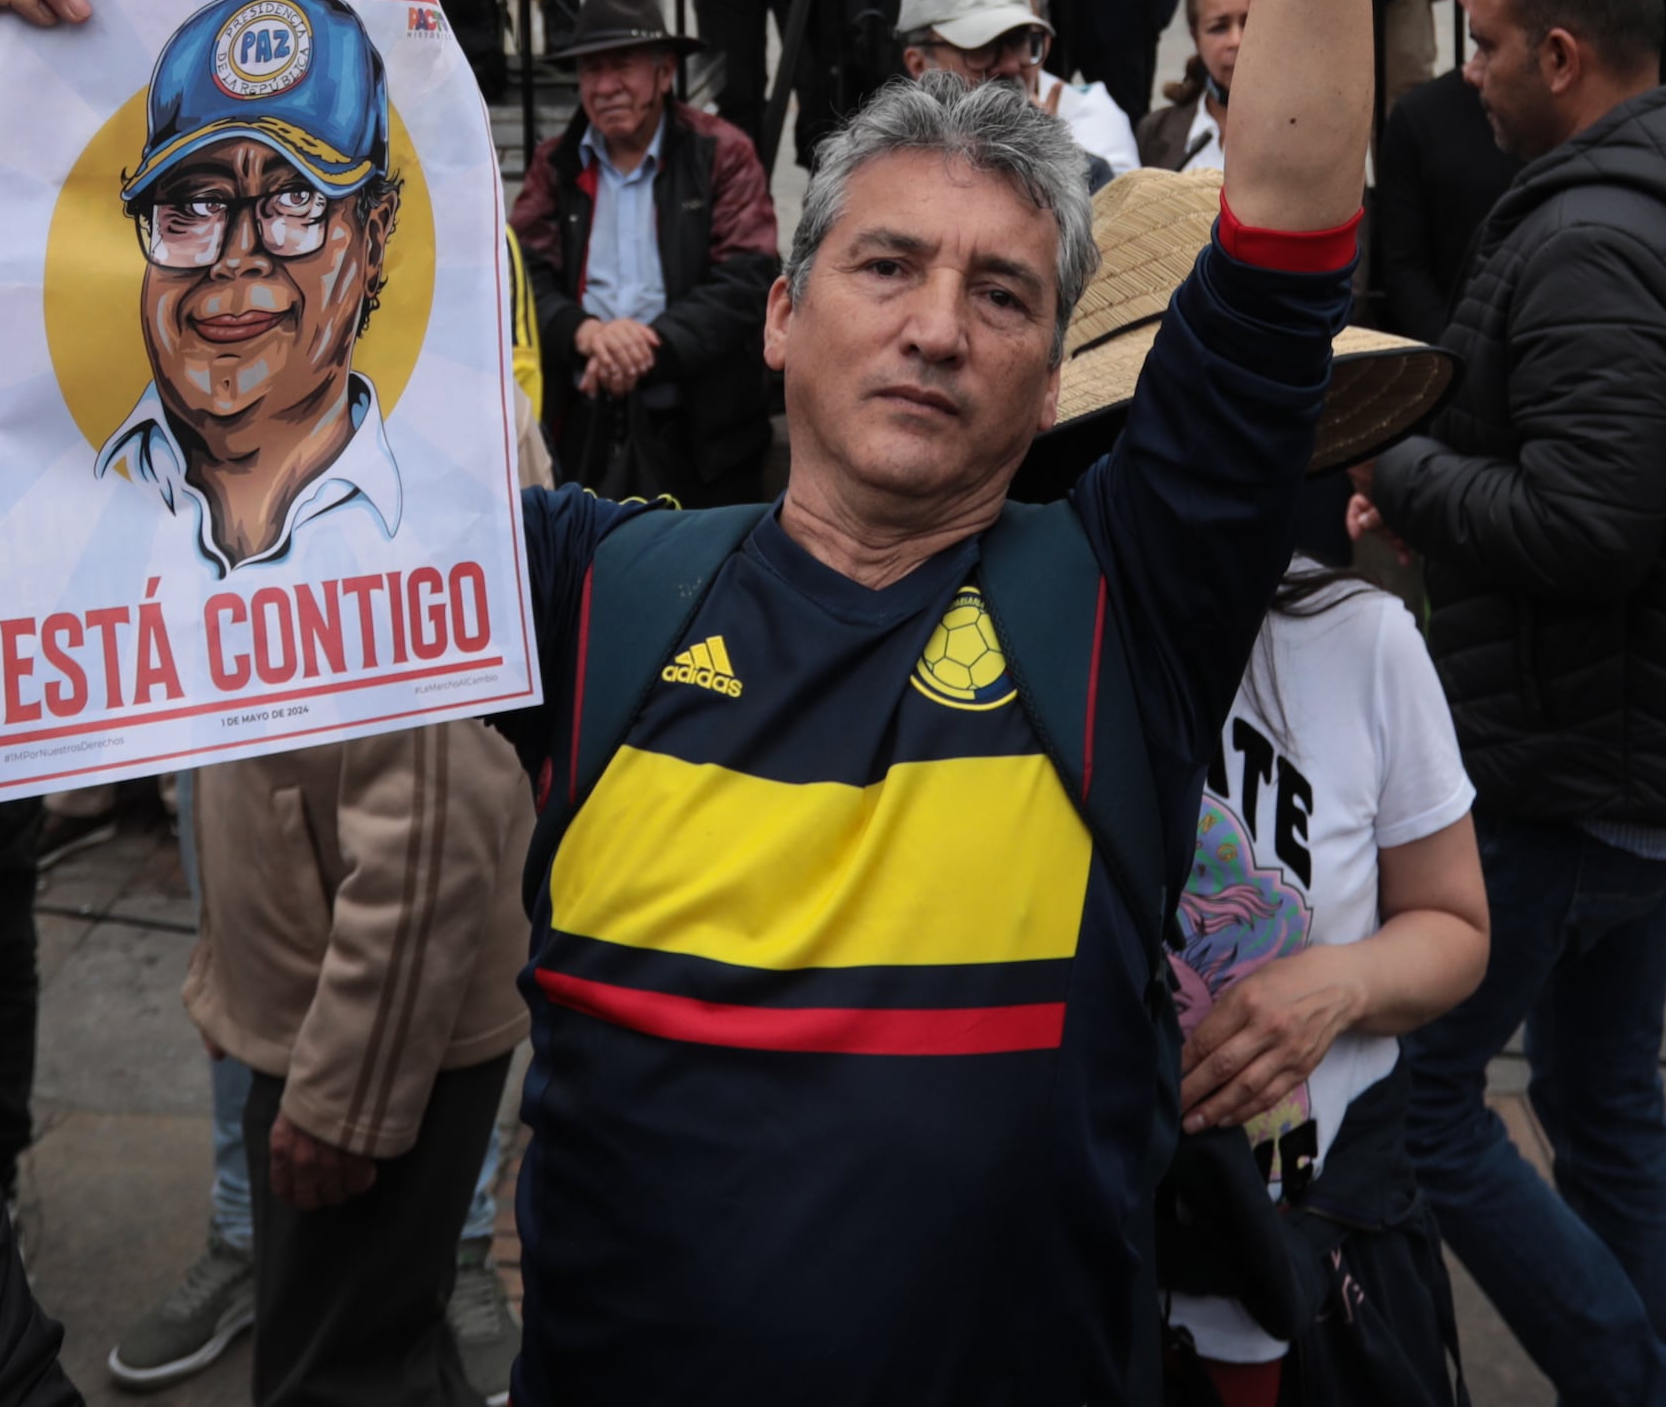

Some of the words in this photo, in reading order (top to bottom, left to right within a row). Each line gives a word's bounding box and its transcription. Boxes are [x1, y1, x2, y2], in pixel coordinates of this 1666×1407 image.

[225, 2, 308, 39] PRESIDENCIA
[239, 28, 291, 65] PAZ
[203, 560, 491, 693] CONTIGO
[661, 665, 743, 698] adidas
[227, 716, 240, 727] DE
[242, 712, 270, 724] MAYO
[272, 709, 286, 719] DE
[287, 705, 310, 716] 2024
